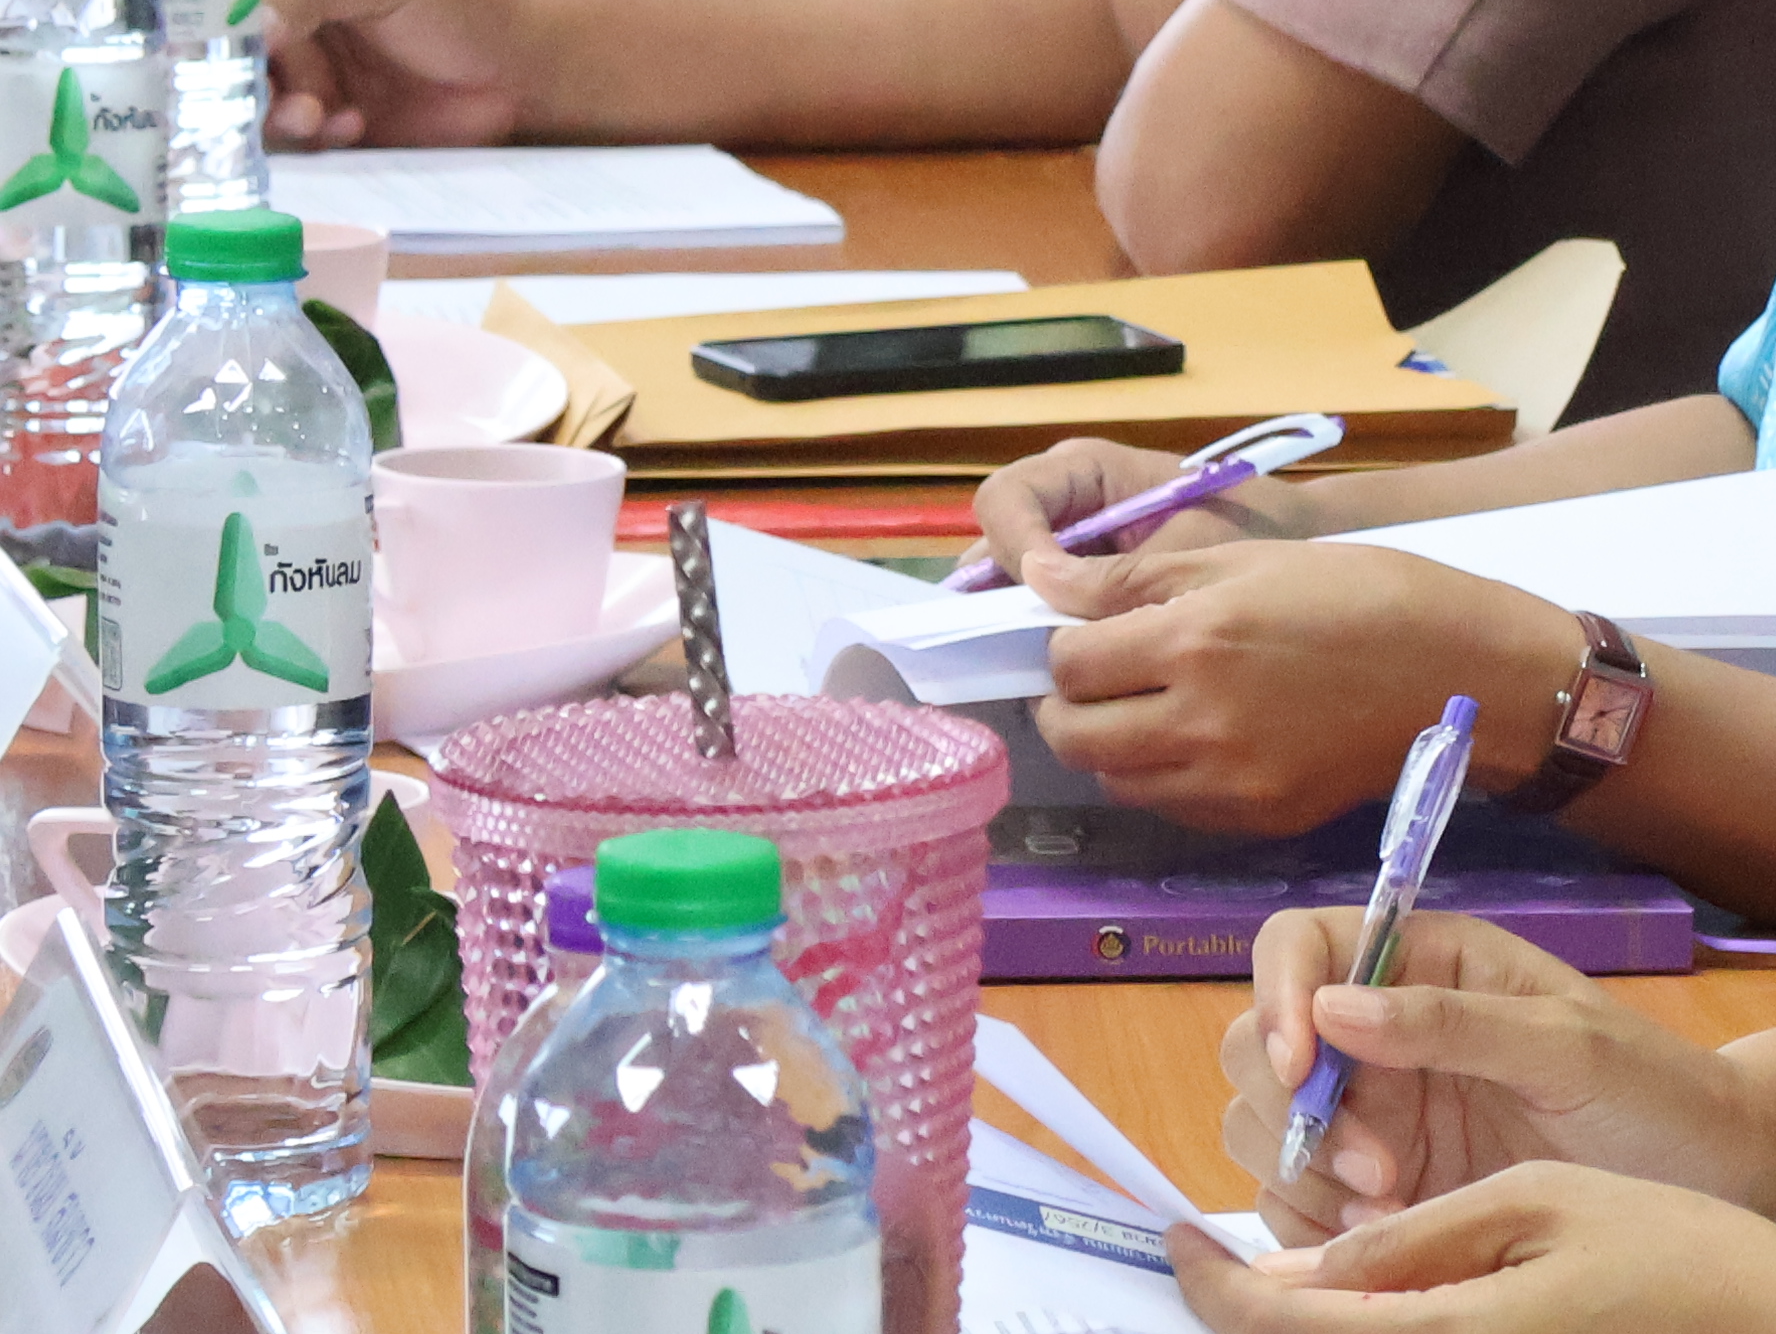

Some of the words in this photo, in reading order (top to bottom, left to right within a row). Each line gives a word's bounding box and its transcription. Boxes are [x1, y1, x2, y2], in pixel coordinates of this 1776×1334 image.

[269, 558, 362, 594] กังหันลม
[1142, 933, 1250, 956] Portable
